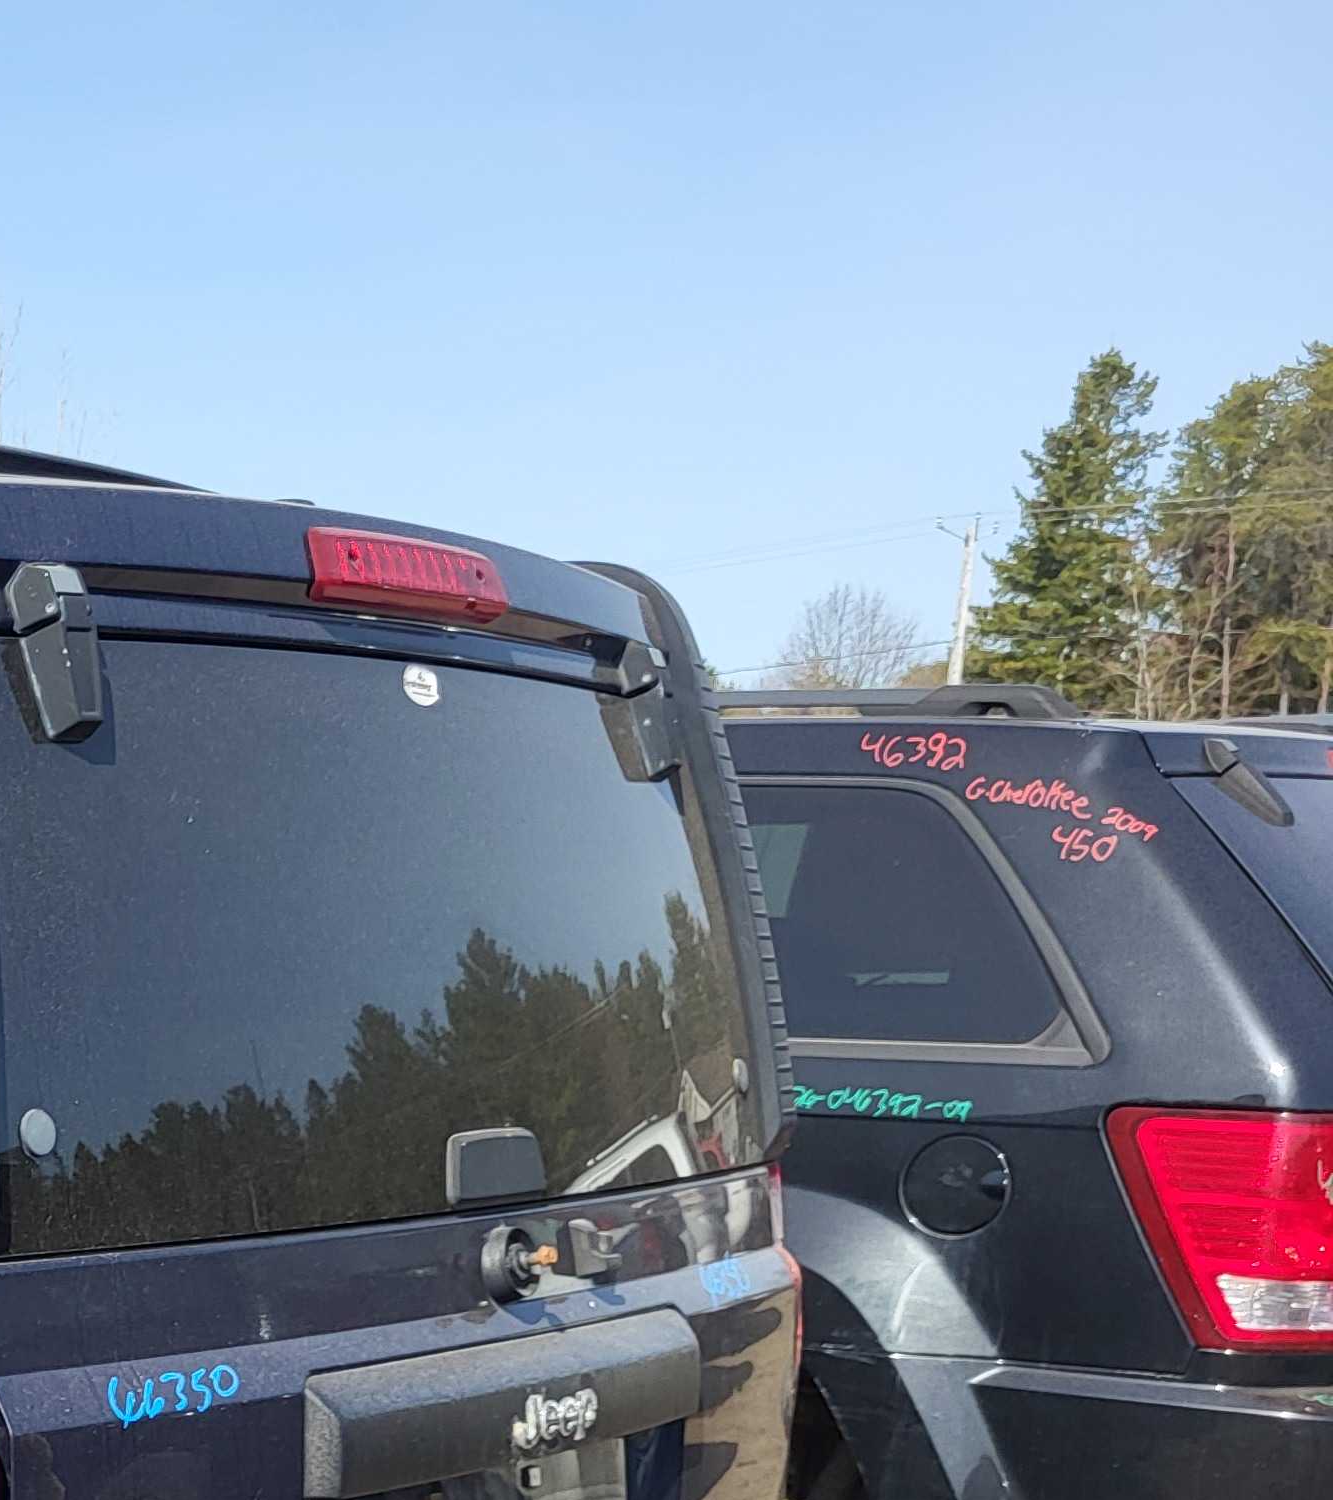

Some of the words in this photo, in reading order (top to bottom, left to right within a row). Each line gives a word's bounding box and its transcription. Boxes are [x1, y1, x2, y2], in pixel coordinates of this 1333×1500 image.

[859, 731, 968, 772] 46392
[1051, 824, 1119, 863] 450
[1100, 806, 1160, 842] 2009
[512, 1387, 598, 1450] Jeep
